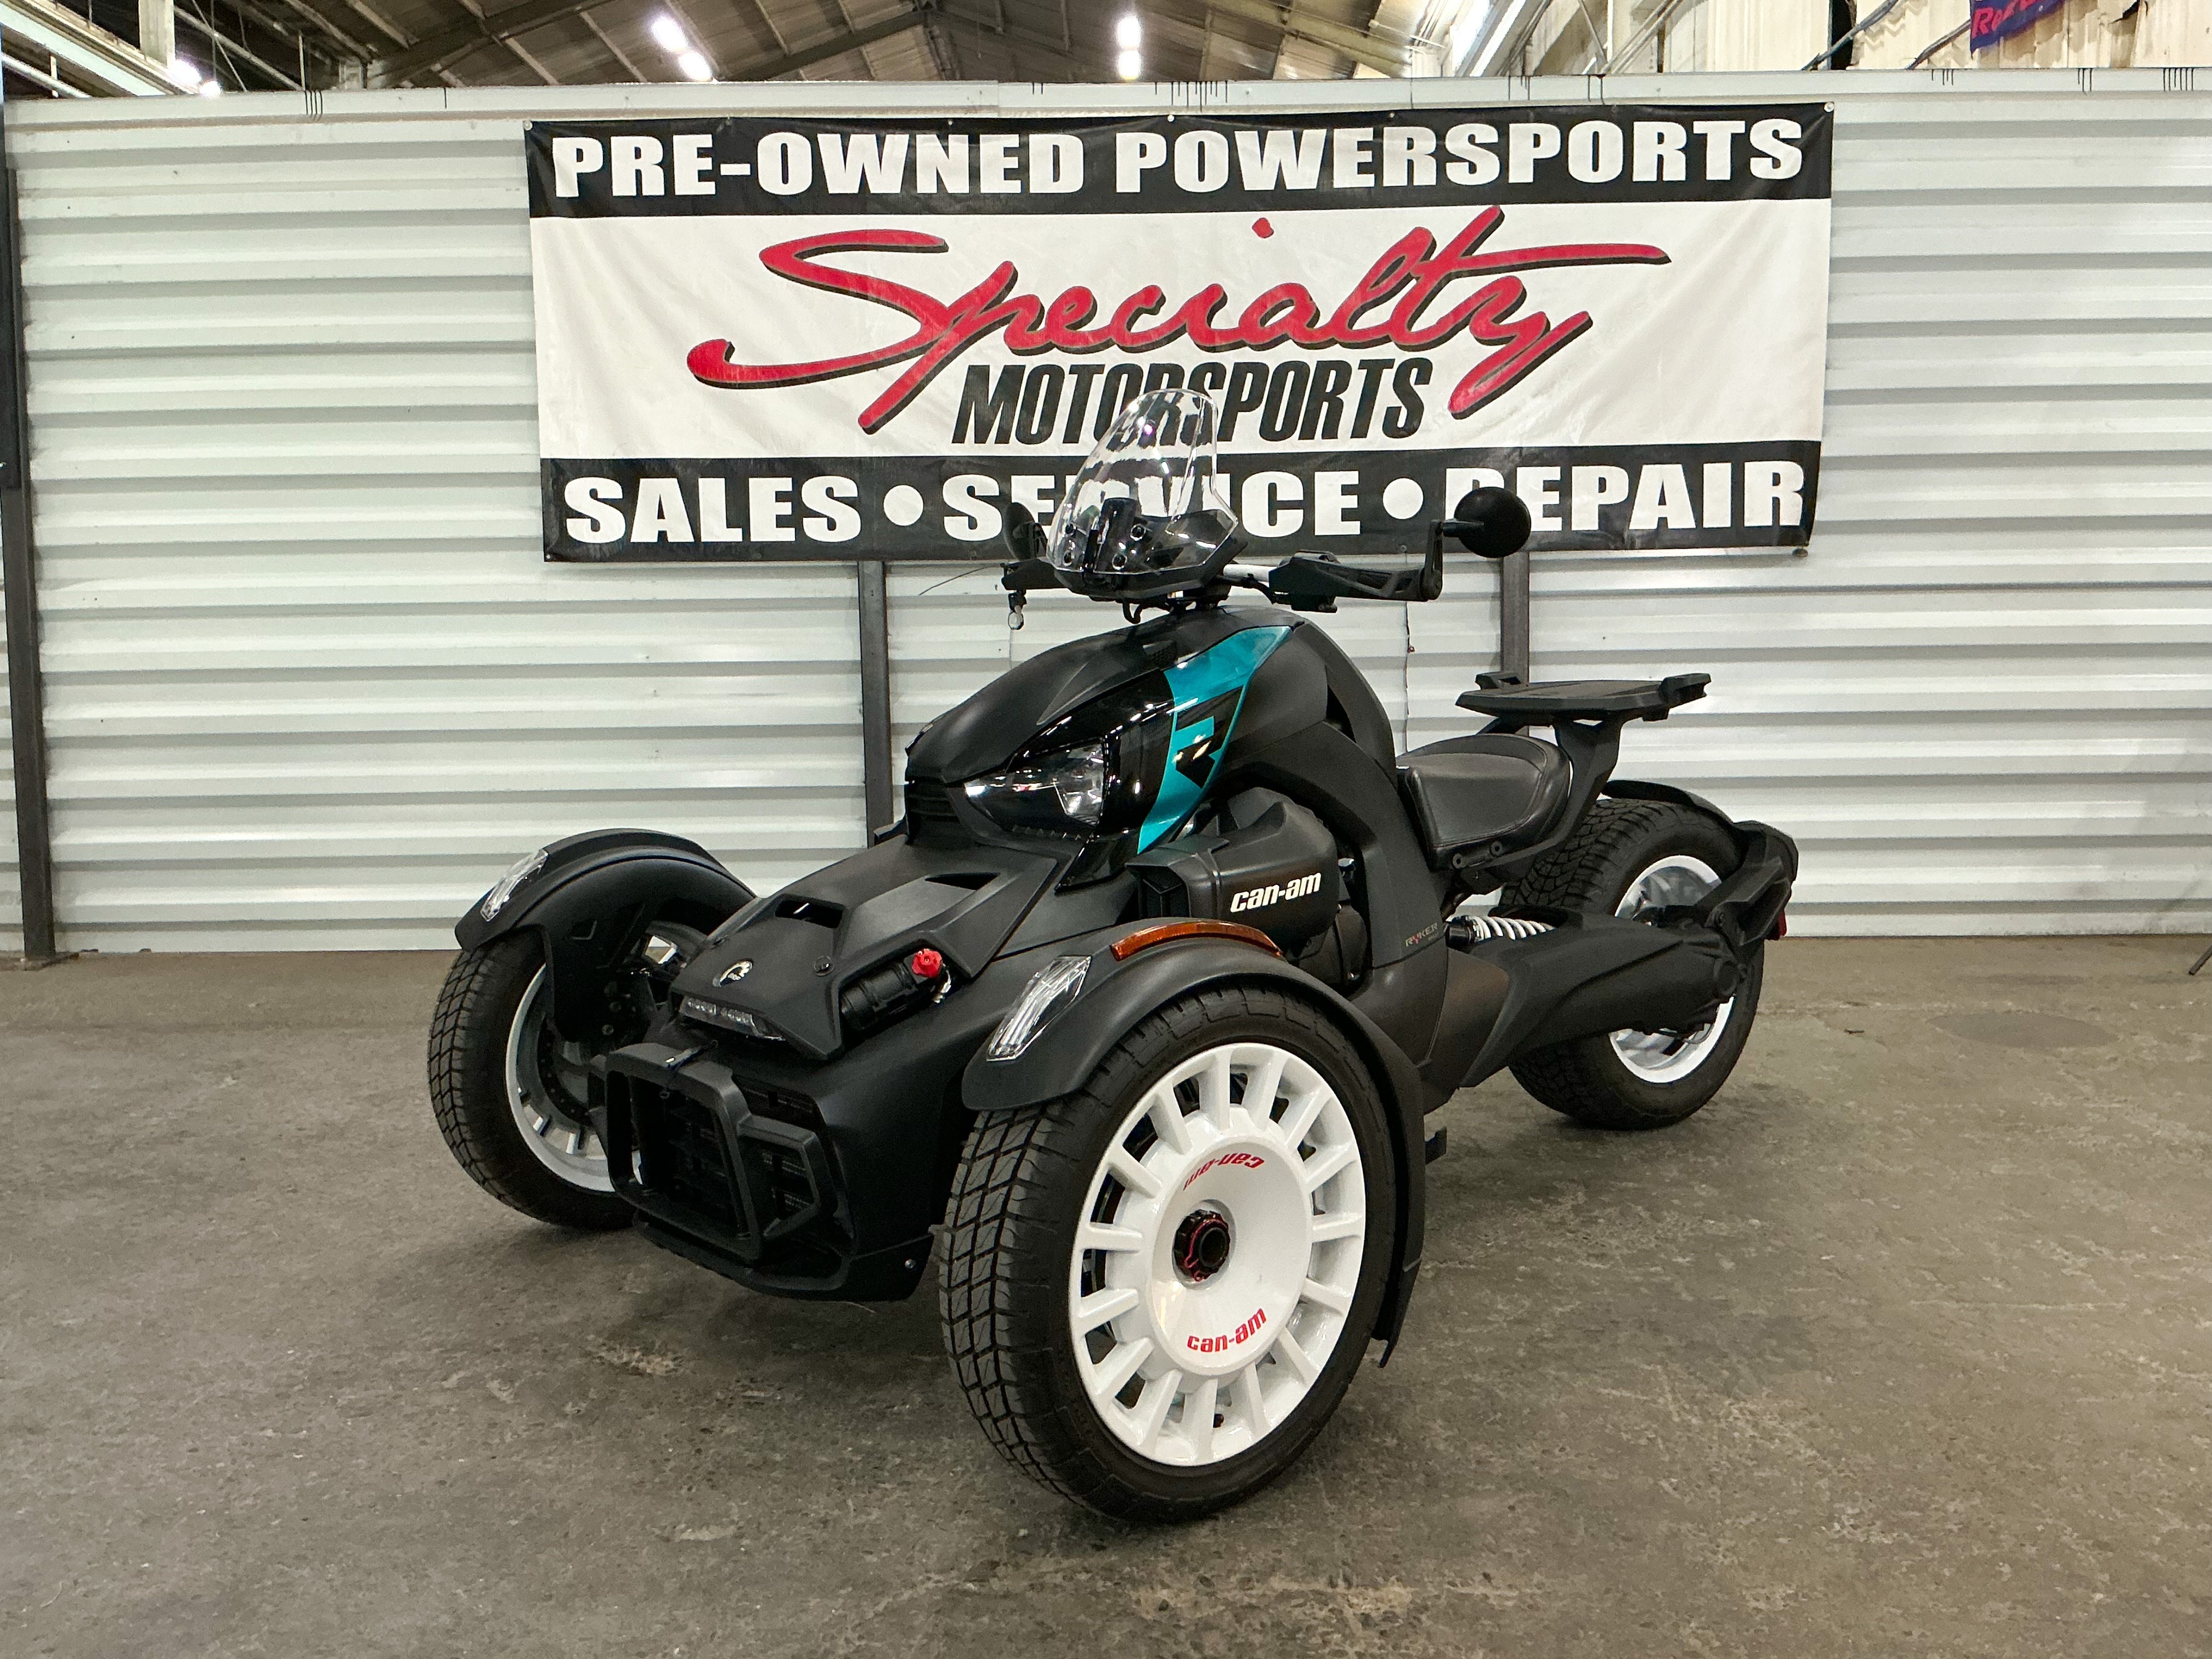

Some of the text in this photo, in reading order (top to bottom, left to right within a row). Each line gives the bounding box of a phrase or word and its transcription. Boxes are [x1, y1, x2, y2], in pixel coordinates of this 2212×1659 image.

[552, 119, 1803, 198] PRE-OWNED POWERSPORTS
[687, 205, 1671, 434] Specialty
[951, 357, 1433, 445] MOTORSPORTS
[564, 475, 861, 543] SALES
[1230, 872, 1322, 913] can-am
[1404, 922, 1438, 947] RYKER
[1187, 1308, 1267, 1353] can-am
